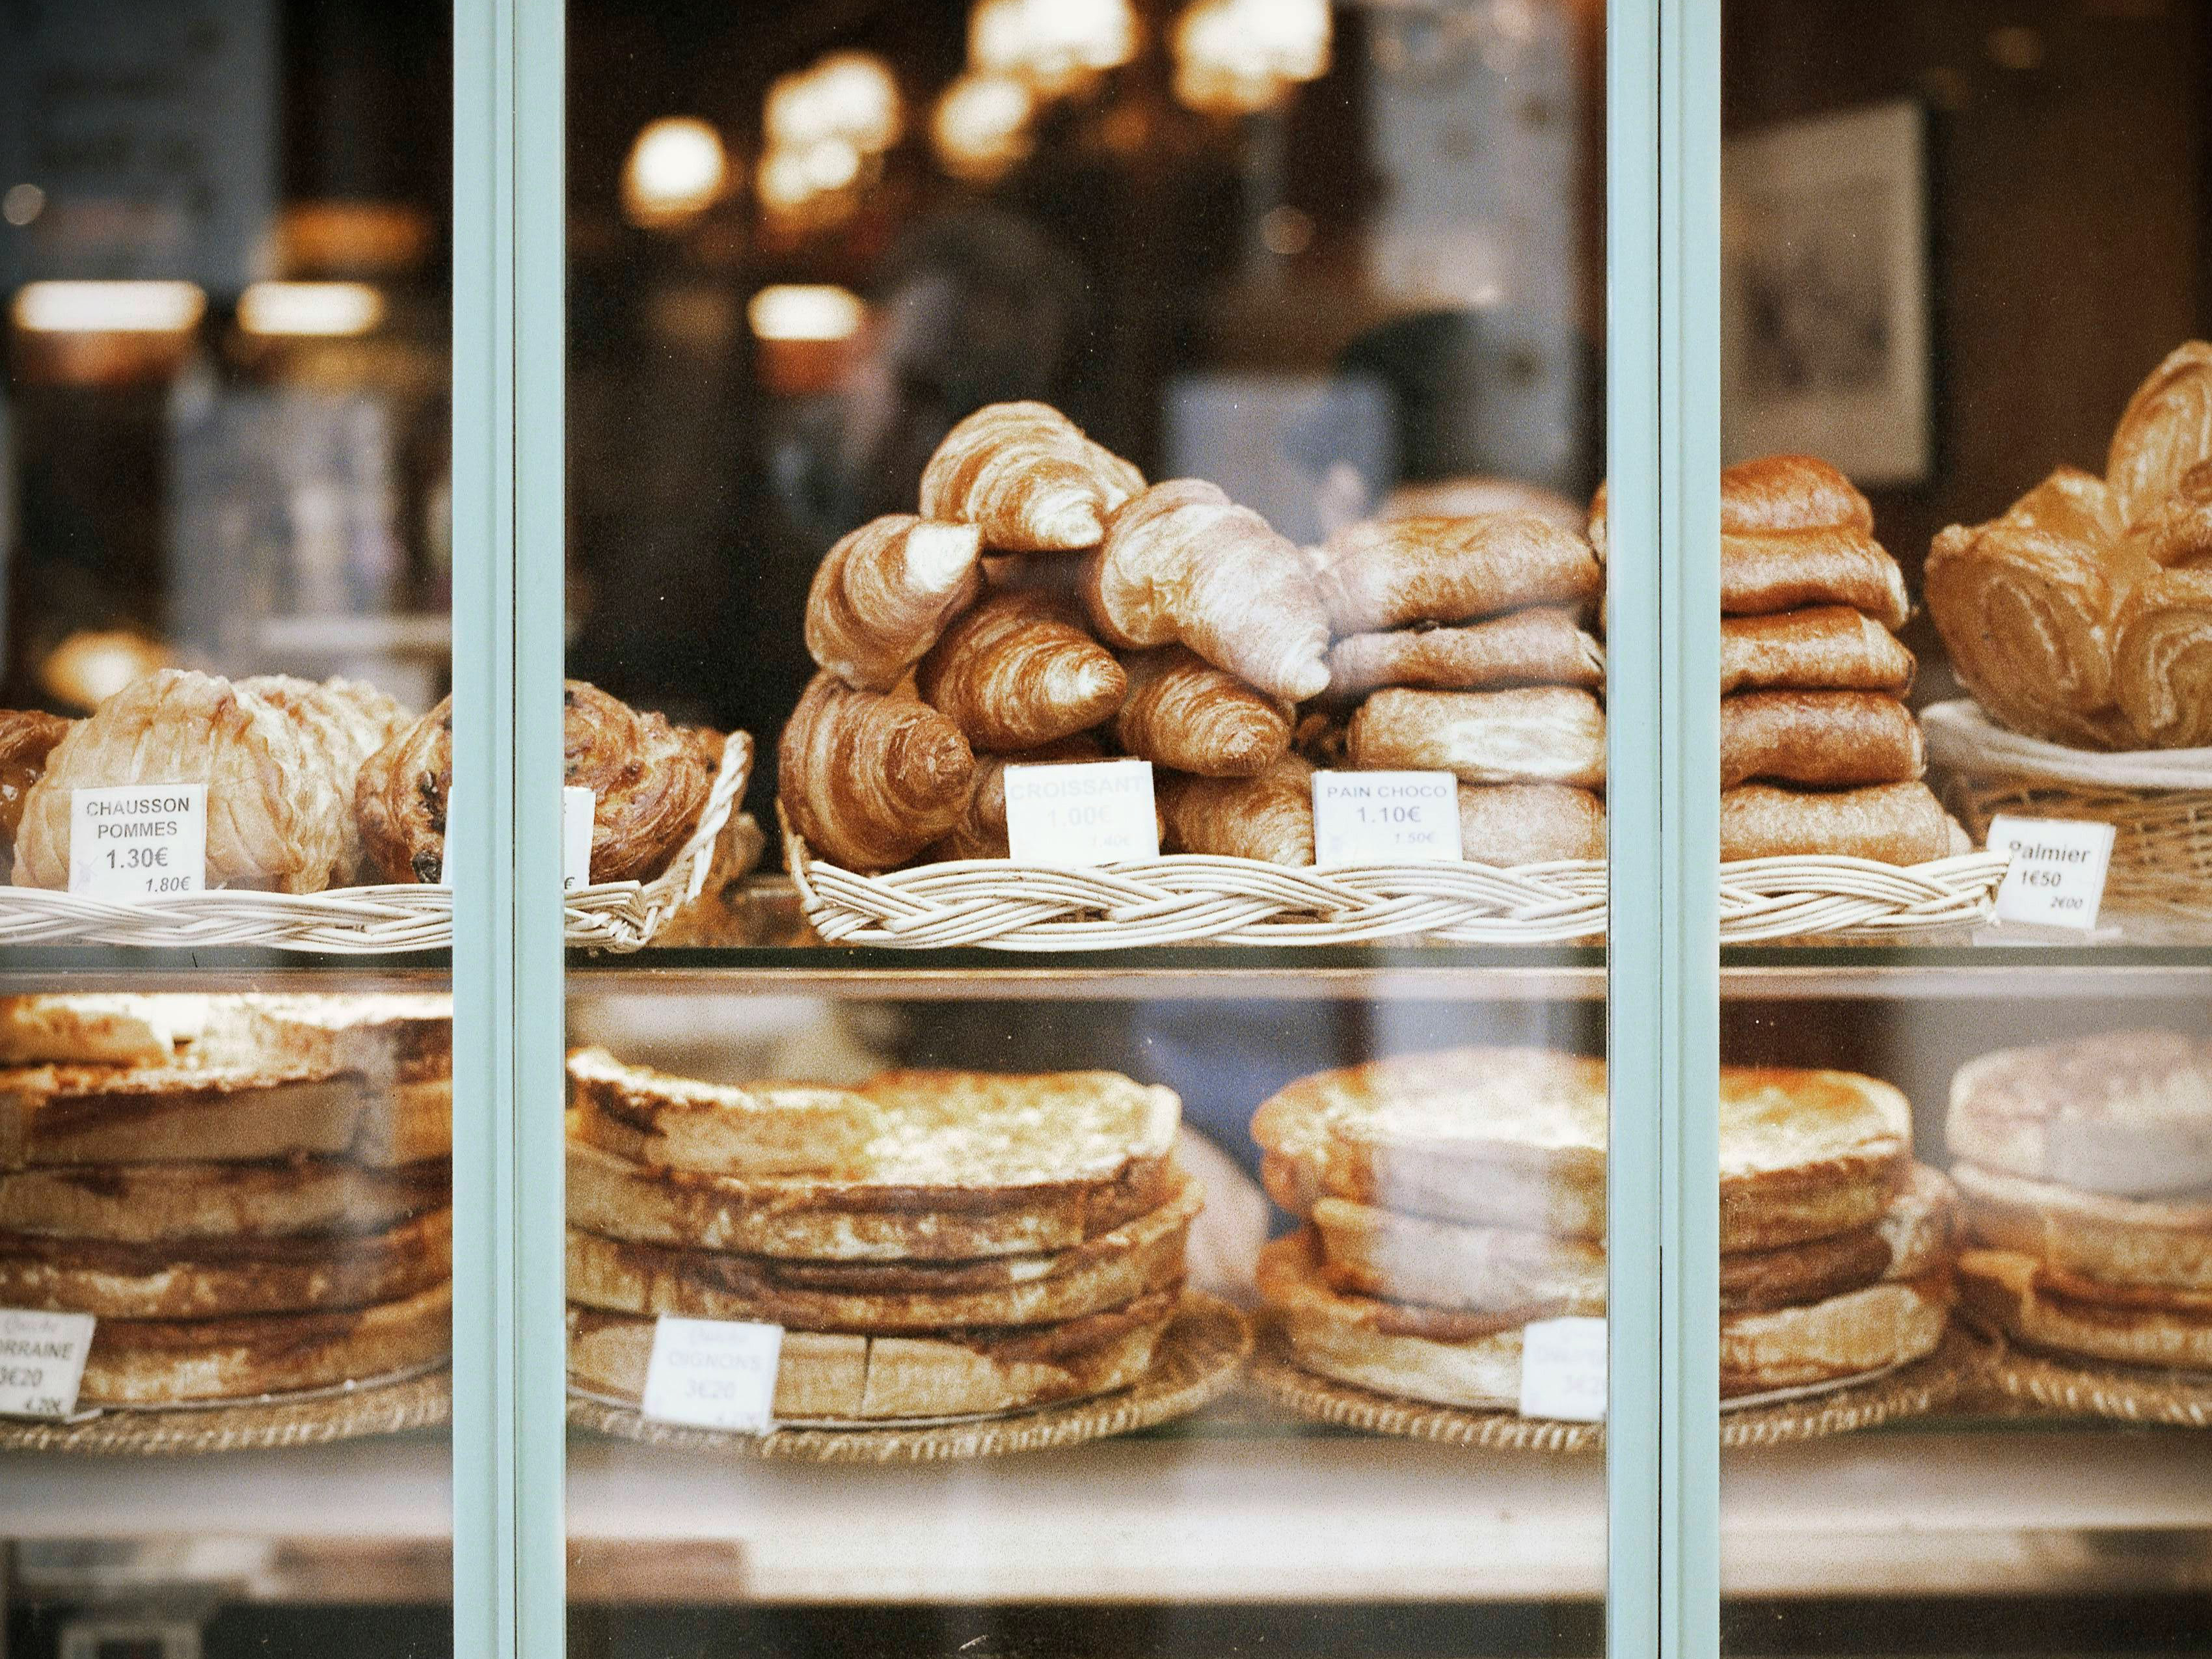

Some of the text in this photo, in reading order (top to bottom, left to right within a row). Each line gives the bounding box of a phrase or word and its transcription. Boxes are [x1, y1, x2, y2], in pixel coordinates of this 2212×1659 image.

[1010, 776, 1144, 800] CROISSANT
[1327, 785, 1447, 798] PAIN CHOCO
[87, 797, 190, 816] CHAUSSON
[1356, 805, 1422, 823] 1.10€
[98, 821, 178, 839] POMMES
[1395, 831, 1436, 844] 150€
[106, 846, 169, 869] 1.30€
[2009, 840, 2091, 863] Palmier
[146, 876, 191, 893] 1.80€
[2021, 870, 2062, 887] 1€50
